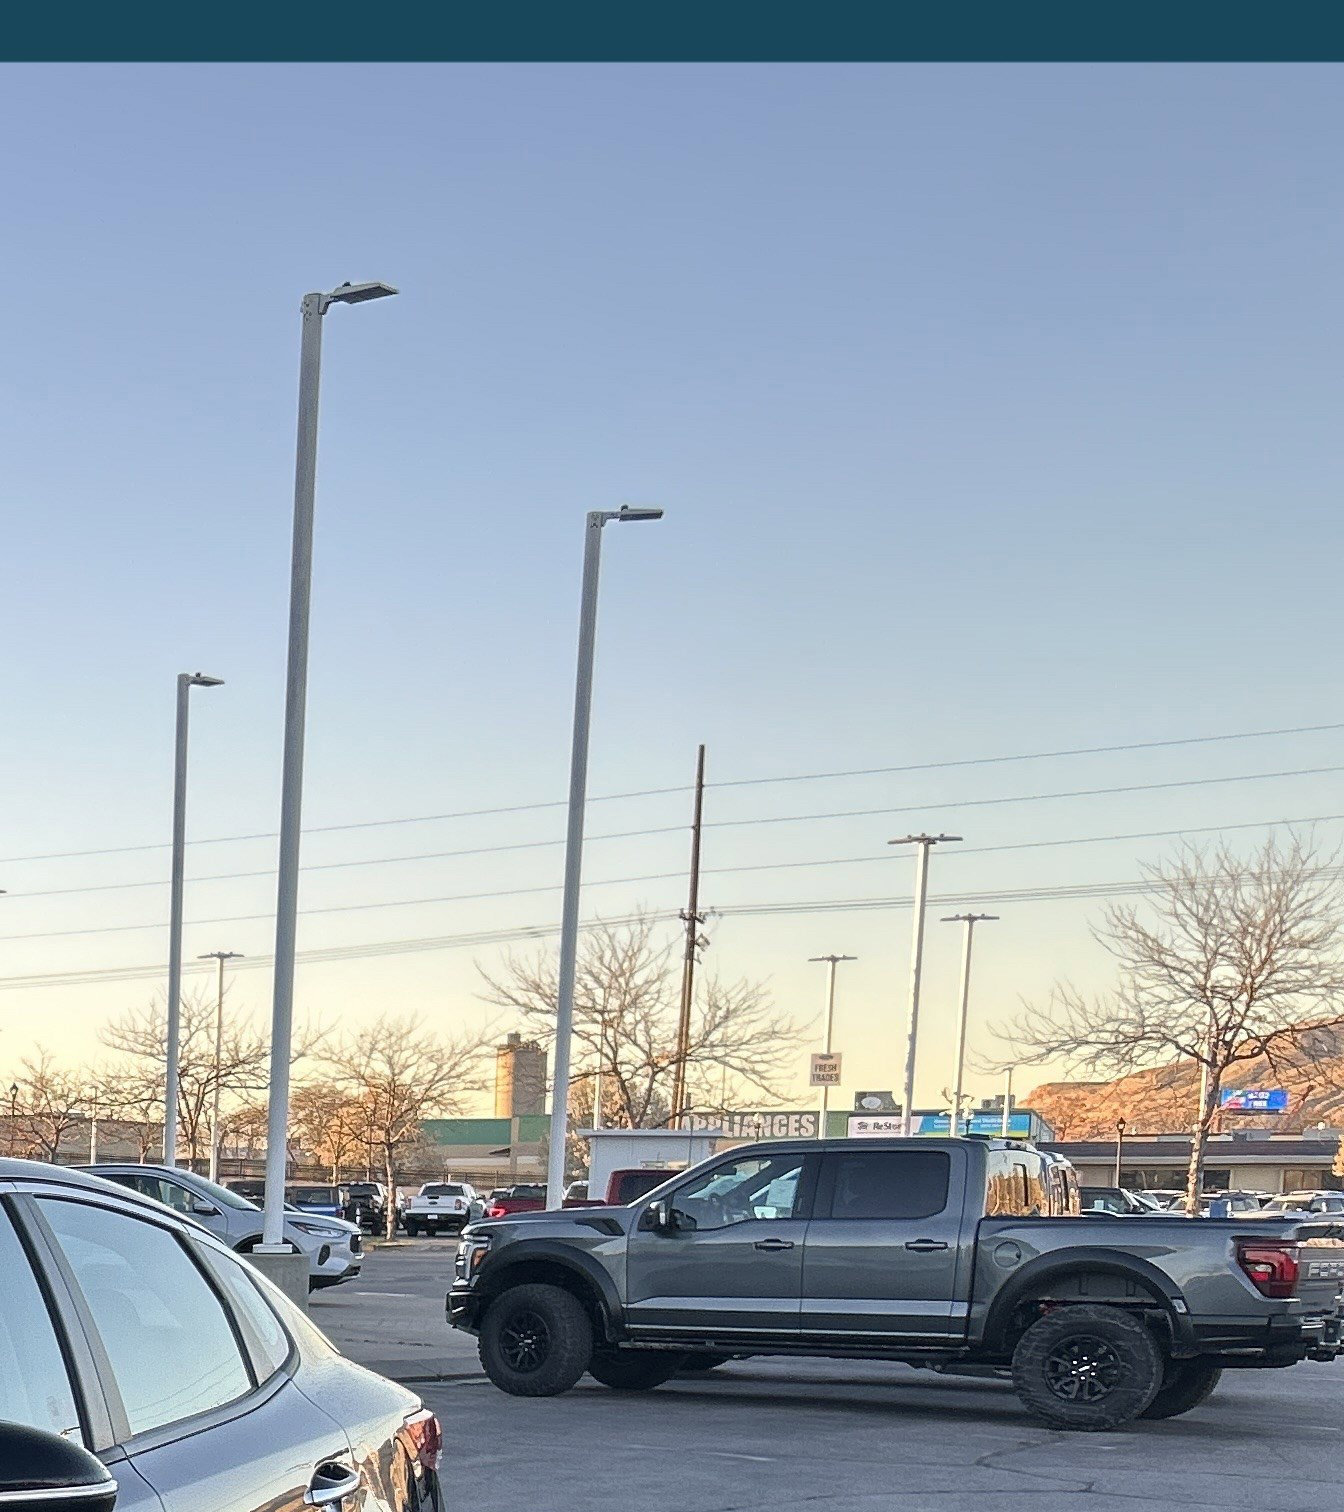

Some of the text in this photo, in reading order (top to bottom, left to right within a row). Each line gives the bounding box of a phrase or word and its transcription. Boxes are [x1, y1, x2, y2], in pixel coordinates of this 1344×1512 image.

[814, 1063, 838, 1073] FRESH
[812, 1073, 840, 1083] TRADES
[681, 1114, 815, 1138] APPLIANCES
